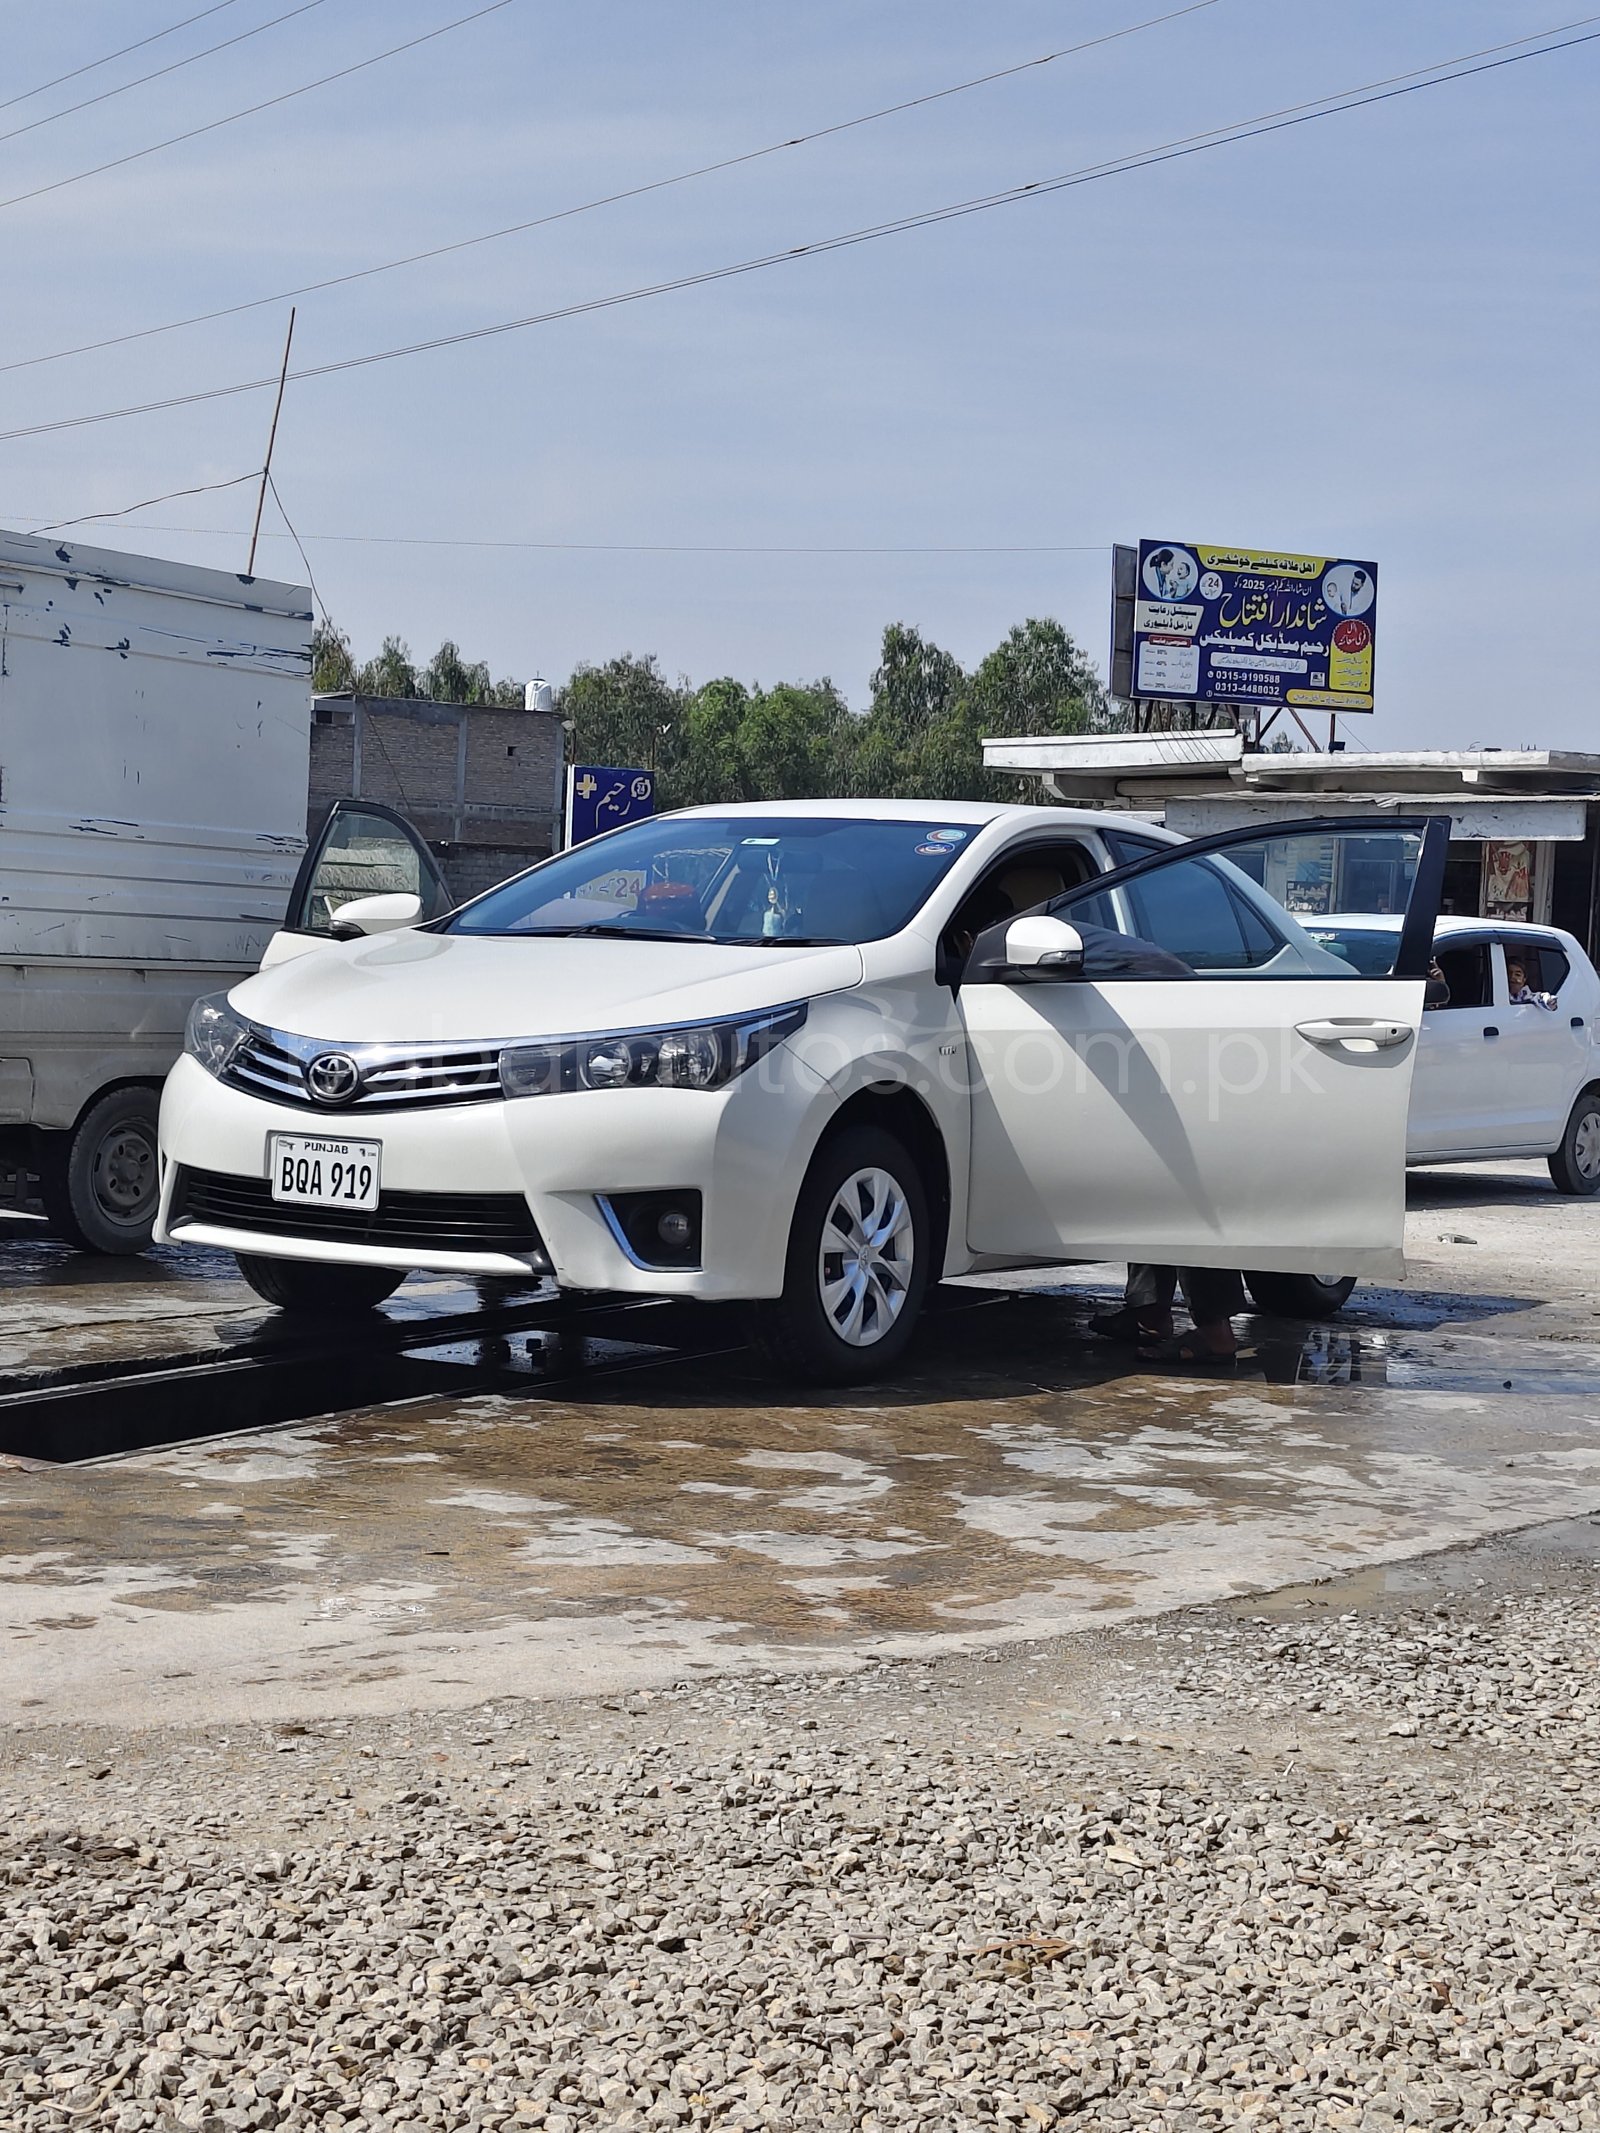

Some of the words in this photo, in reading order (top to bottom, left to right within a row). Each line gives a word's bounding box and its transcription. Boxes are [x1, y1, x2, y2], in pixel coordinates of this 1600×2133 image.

[1207, 553, 1250, 568] خوشخبری
[1208, 577, 1219, 589] 24
[1219, 592, 1275, 628] افتتاح
[1272, 597, 1328, 631] شاندار
[1199, 629, 1255, 652] کمپلیکس
[1255, 631, 1300, 654] میڈیکل
[1300, 641, 1330, 657] رحیم
[595, 782, 631, 830] رحیم
[304, 1141, 349, 1155] PUNJAB
[281, 1156, 322, 1196] BQA
[331, 1162, 372, 1200] 919
